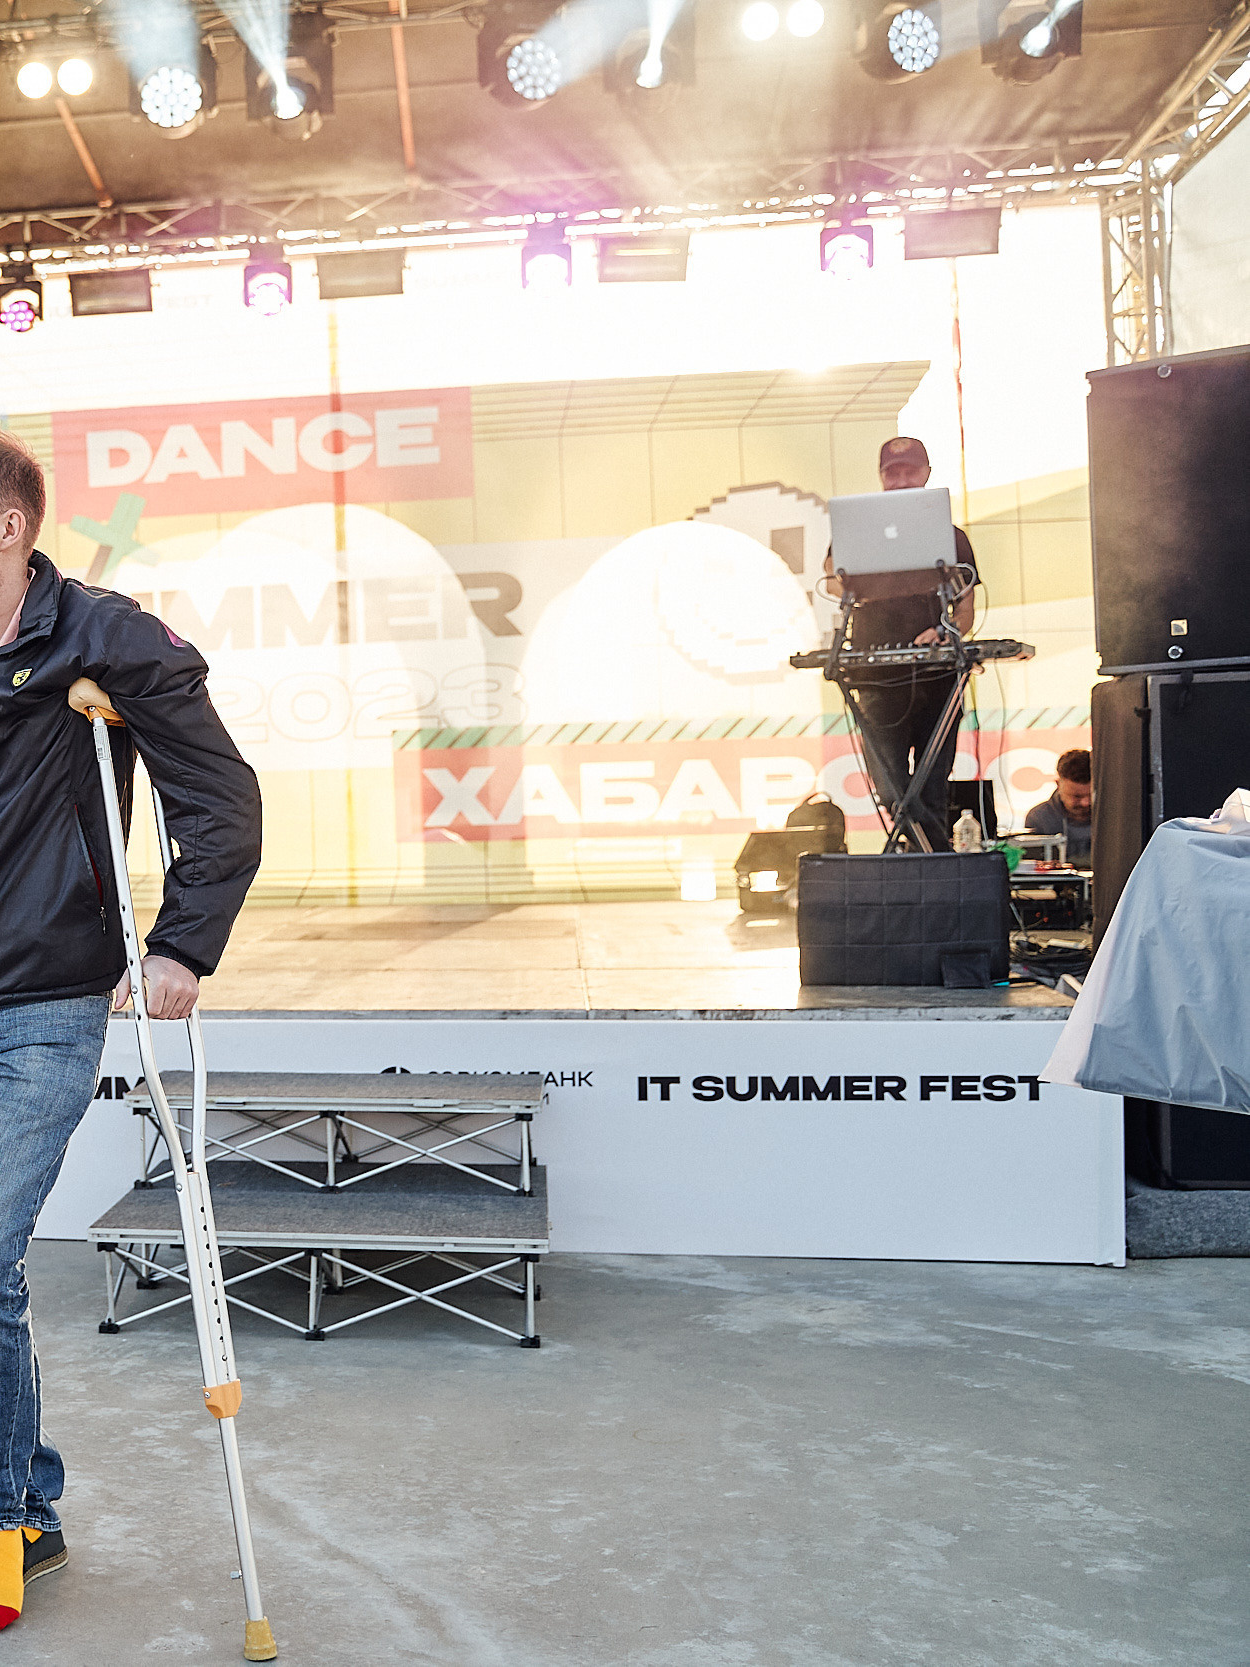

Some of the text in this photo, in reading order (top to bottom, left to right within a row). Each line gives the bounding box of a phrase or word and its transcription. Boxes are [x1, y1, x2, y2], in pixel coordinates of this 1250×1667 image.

[85, 406, 440, 488] DANCE
[131, 572, 523, 652] MMER
[423, 748, 1059, 829] ХАБАРОС
[637, 1075, 1051, 1102] IT SUMMER FEST
